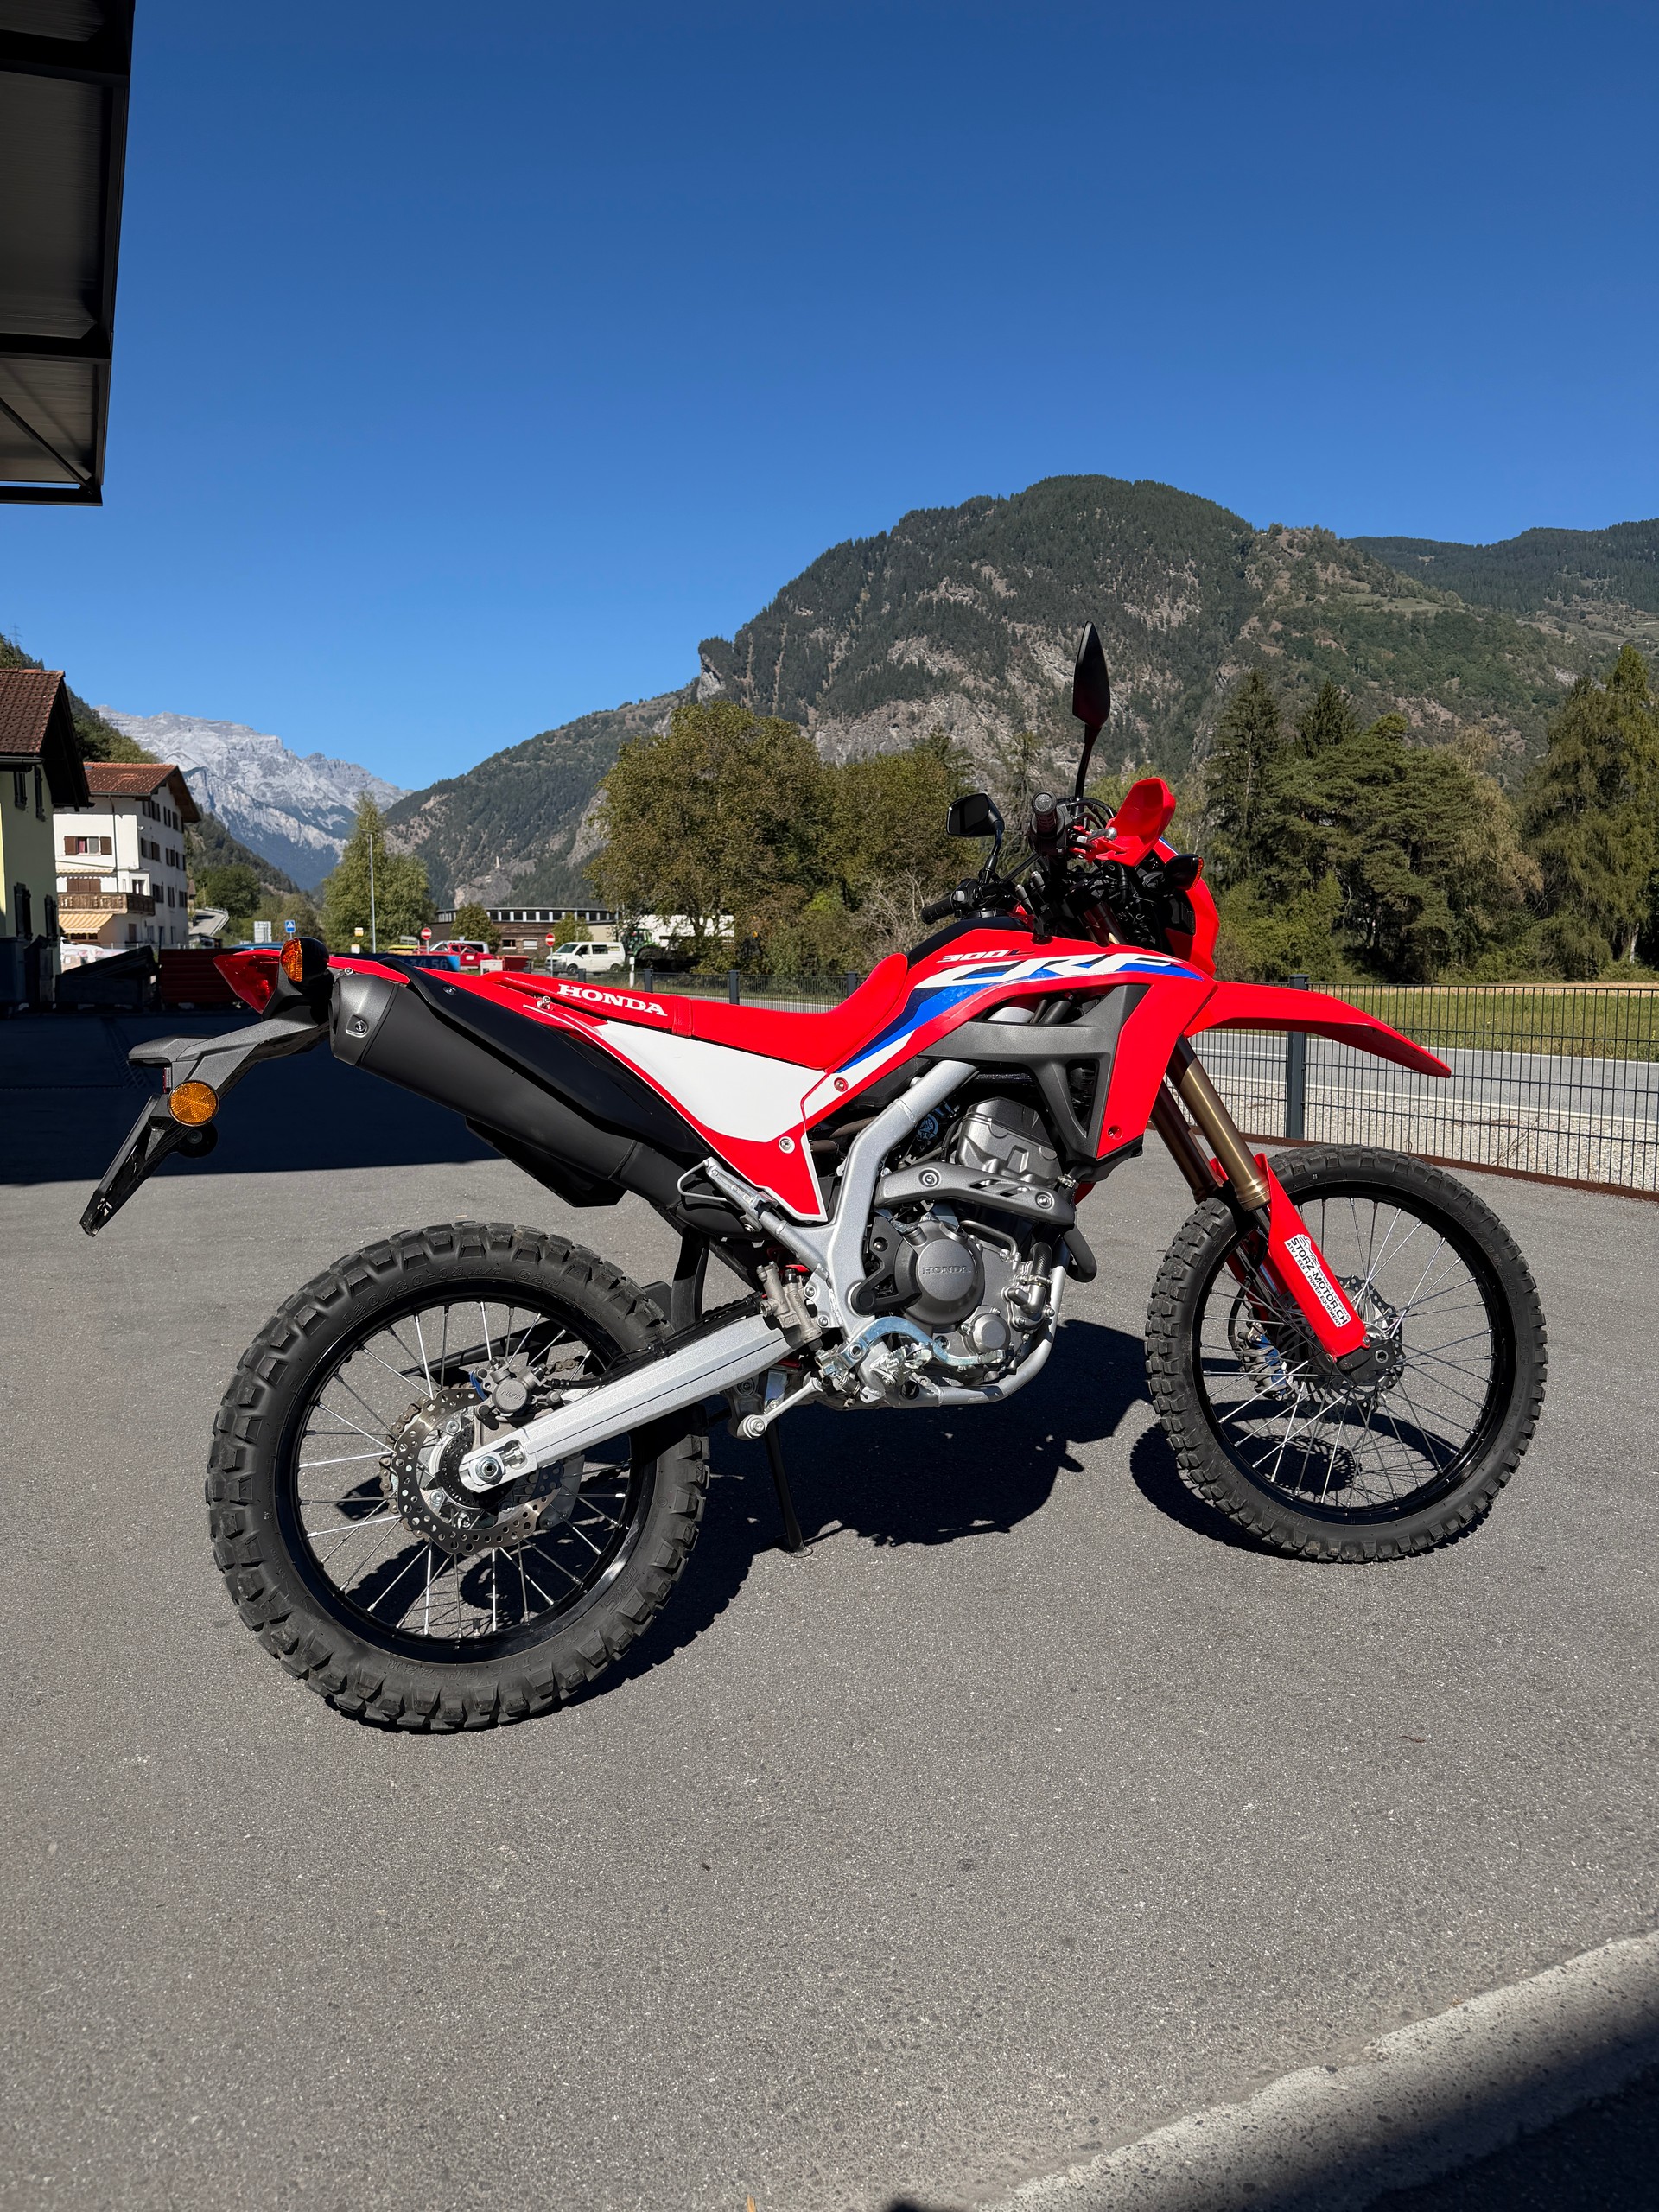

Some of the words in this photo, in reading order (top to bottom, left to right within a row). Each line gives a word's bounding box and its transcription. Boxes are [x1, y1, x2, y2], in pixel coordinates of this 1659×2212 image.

[914, 953, 1185, 989] CRF
[937, 949, 1036, 963] 300L
[557, 983, 668, 1017] HONDA
[921, 1264, 969, 1275] HONDA
[1291, 1237, 1348, 1325] STORZ-MOTOR.CH
[1307, 1274, 1322, 1296] POWER
[1319, 1294, 1342, 1326] EQUIPMENT
